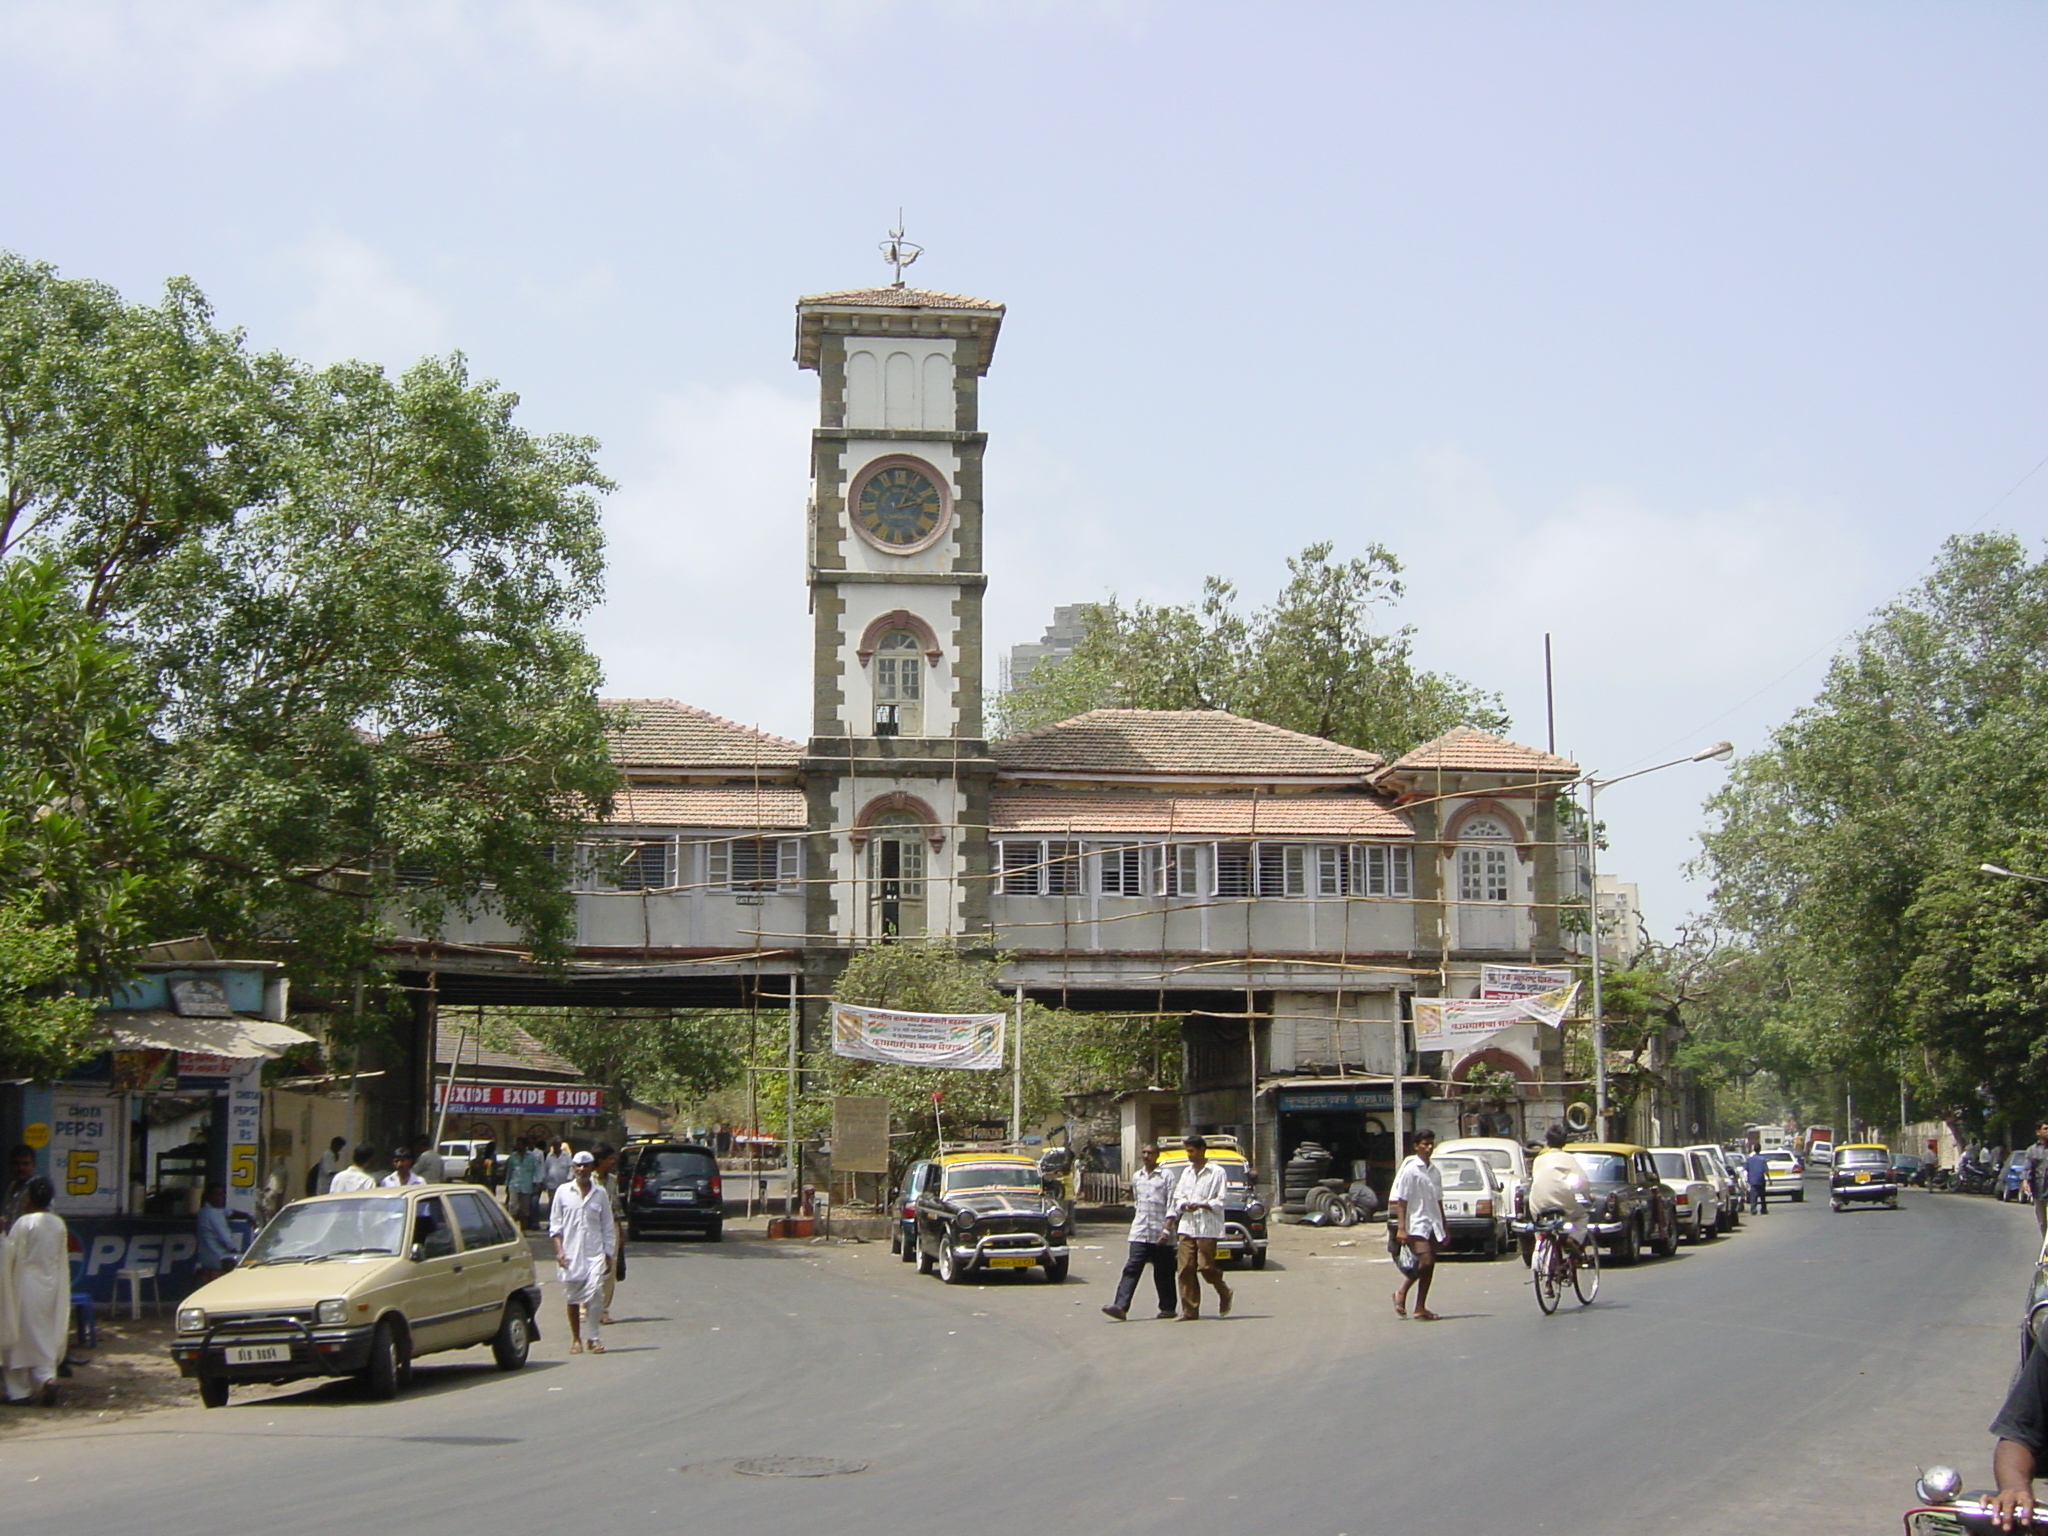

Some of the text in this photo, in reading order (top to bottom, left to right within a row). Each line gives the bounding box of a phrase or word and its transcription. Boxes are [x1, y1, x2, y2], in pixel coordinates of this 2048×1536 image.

[503, 1088, 546, 1104] EXIDE
[556, 1090, 598, 1106] EXIDE
[55, 1121, 104, 1138] PEPSI
[66, 1150, 100, 1195] 5
[231, 1144, 257, 1188] 5
